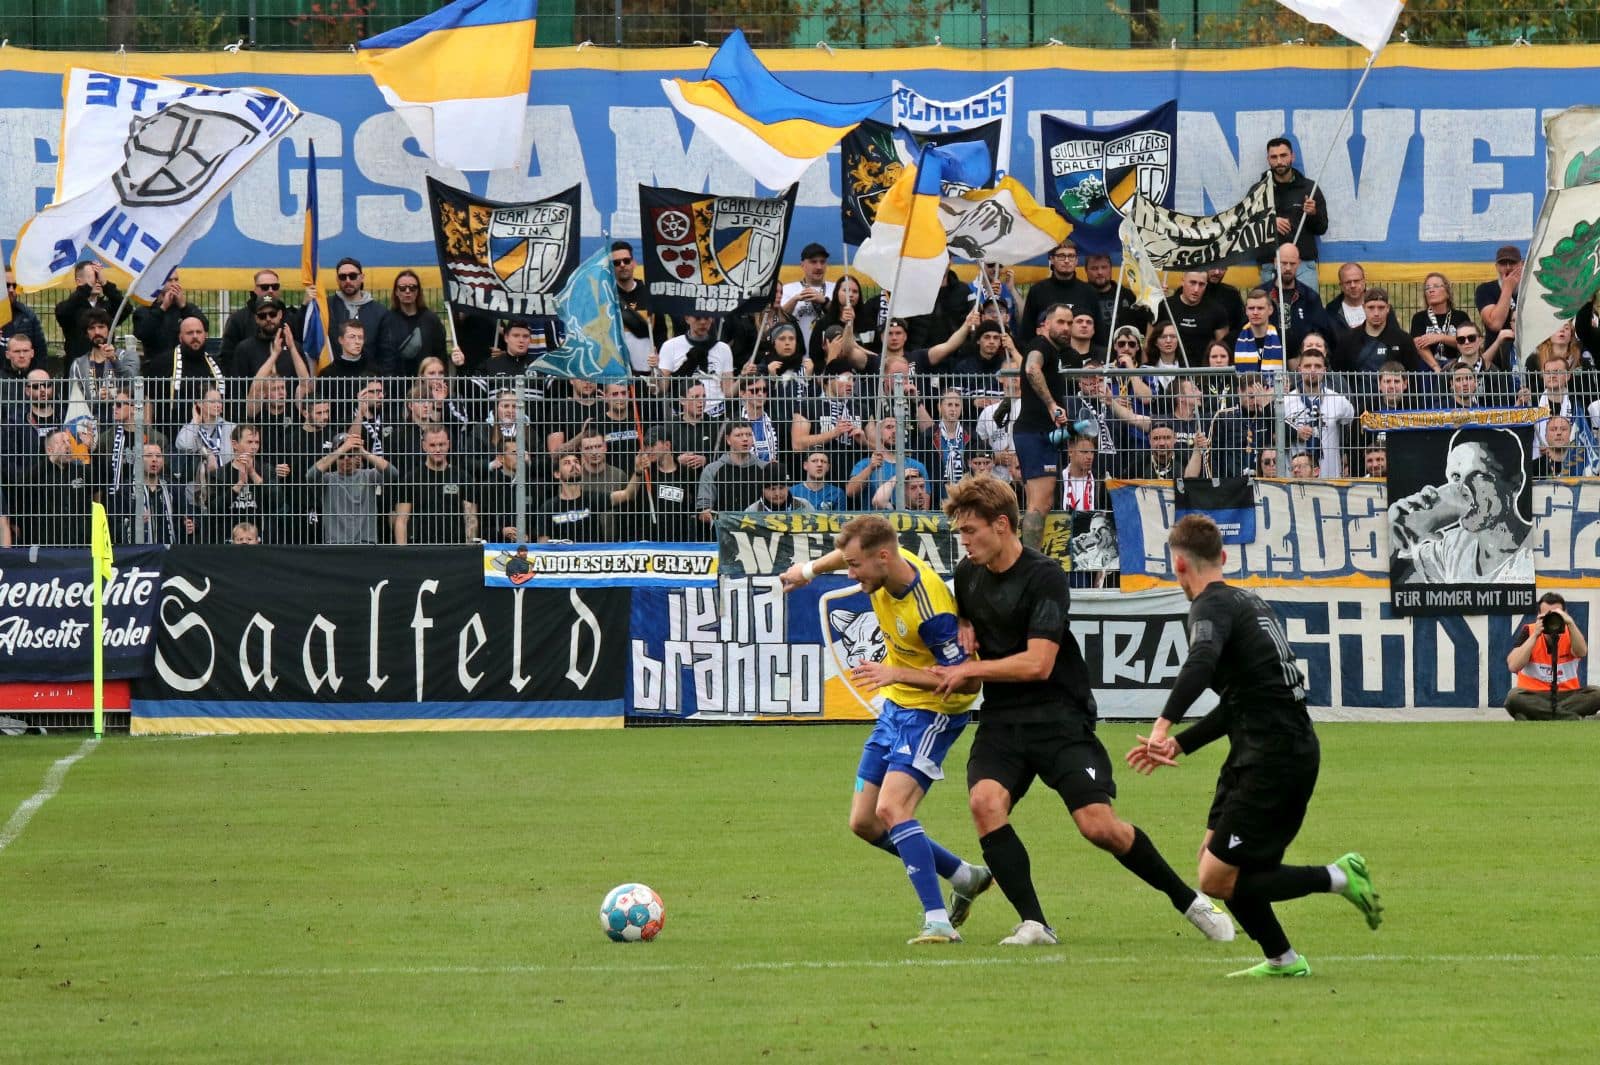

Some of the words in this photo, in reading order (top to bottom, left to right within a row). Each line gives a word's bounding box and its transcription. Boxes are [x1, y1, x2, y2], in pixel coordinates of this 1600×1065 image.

[1109, 139, 1137, 154] CARL
[1140, 135, 1167, 152] ZEISS
[1119, 153, 1156, 166] JENA
[498, 208, 530, 224] CARL
[532, 207, 567, 223] ZEISS
[731, 214, 771, 228] JENA
[507, 226, 552, 236] JENA
[695, 298, 738, 312] NORD
[533, 554, 650, 575] ADOLESCENT
[653, 555, 713, 575] CREW
[1395, 591, 1422, 608] FÜR
[1425, 590, 1472, 607] IMMER
[1476, 590, 1503, 606] MIT
[154, 574, 602, 703] Saalfeld
[631, 638, 823, 713] branco
